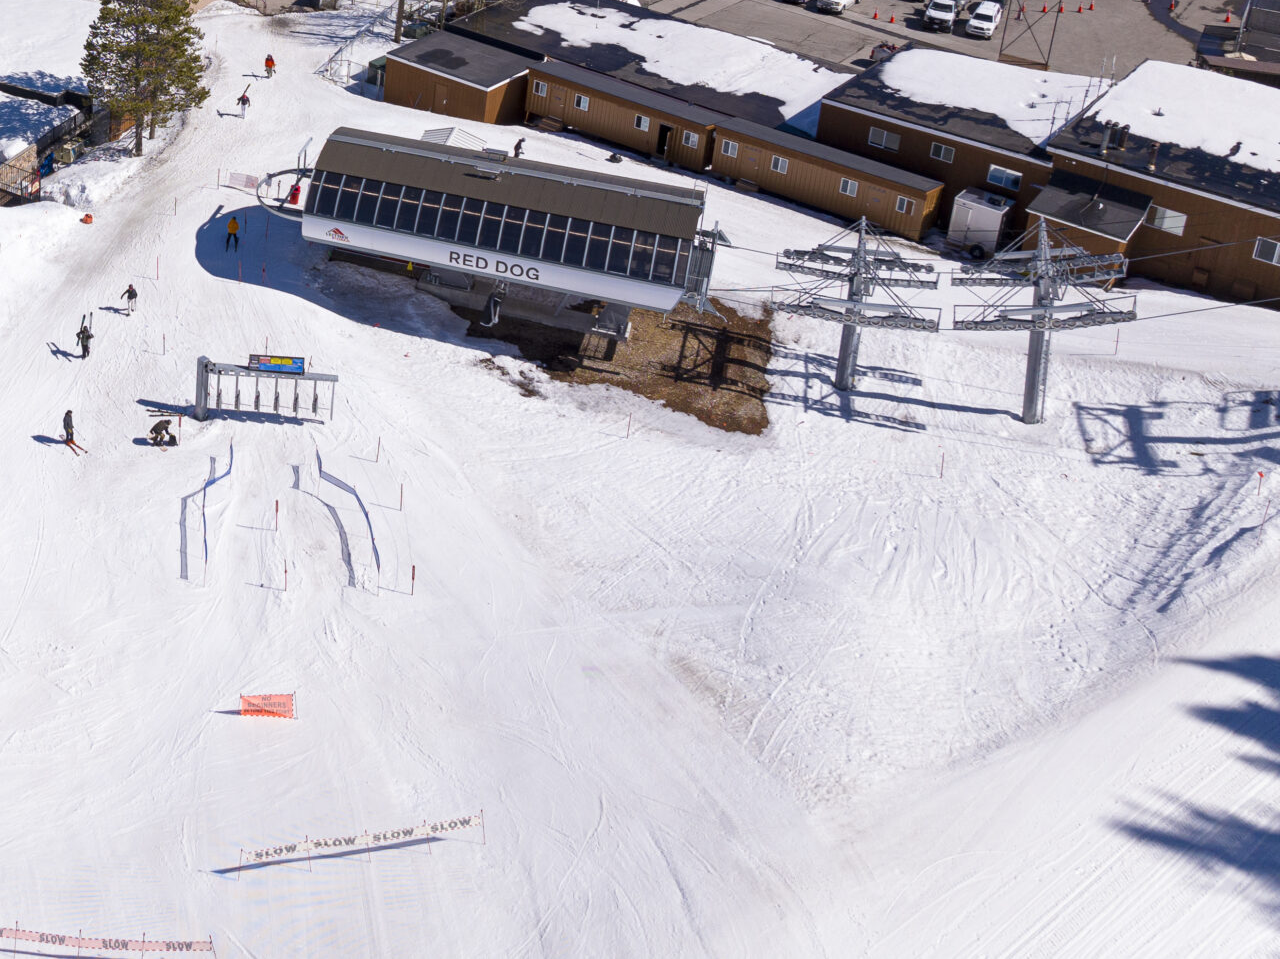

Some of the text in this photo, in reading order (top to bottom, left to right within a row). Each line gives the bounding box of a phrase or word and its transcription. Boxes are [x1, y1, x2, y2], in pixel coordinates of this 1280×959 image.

[449, 250, 540, 281] RED DOG
[254, 818, 472, 860] SLOW SLOW SLOW SLOW
[39, 933, 66, 945] SLOW
[102, 939, 129, 949] SLOW
[165, 941, 193, 950] SLOW
